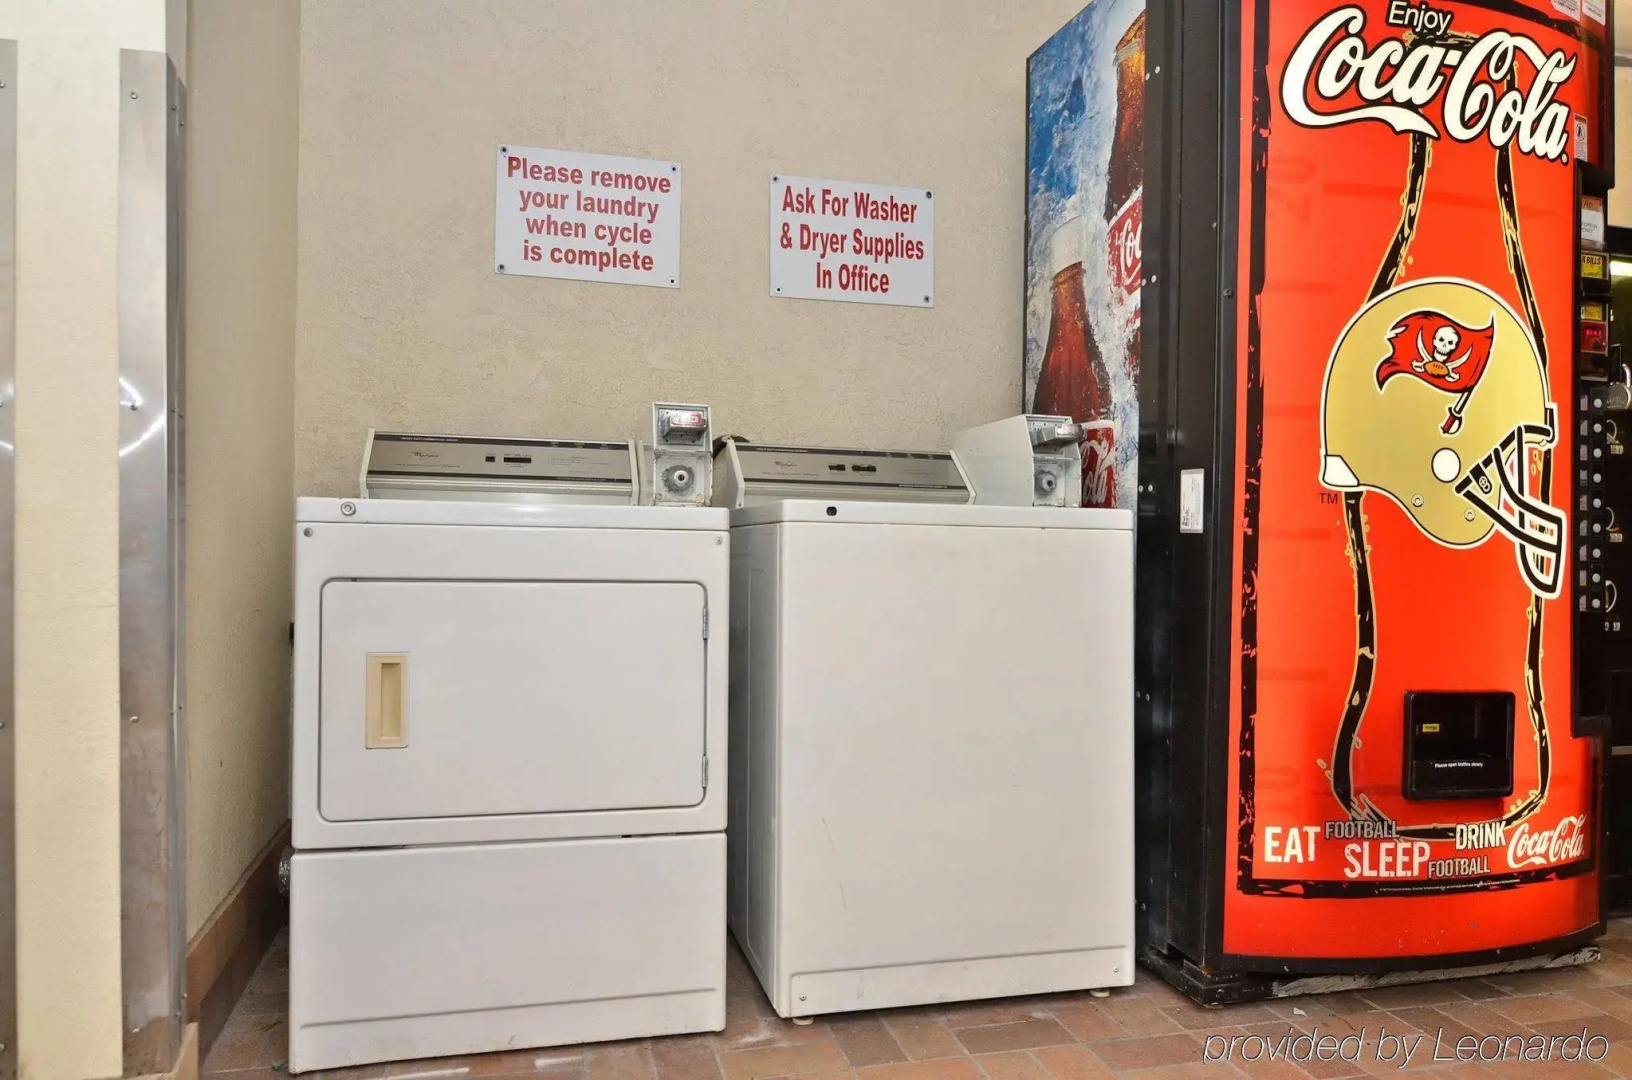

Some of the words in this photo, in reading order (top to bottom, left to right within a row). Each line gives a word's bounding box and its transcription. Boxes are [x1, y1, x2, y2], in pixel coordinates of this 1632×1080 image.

[1388, 1, 1452, 35] Enjoy
[1281, 6, 1577, 162] Coca-Cola
[507, 156, 583, 184] Please
[591, 170, 671, 193] remove
[519, 190, 569, 212] your
[576, 190, 659, 224] laundry
[782, 185, 815, 214] Ask
[821, 189, 849, 217] For
[854, 192, 917, 223] Washer
[526, 214, 586, 238] when
[594, 223, 652, 247] cycle
[780, 222, 792, 249] &
[800, 223, 847, 259] Dryer
[852, 228, 924, 264] Supplies
[523, 239, 542, 262] is
[550, 247, 654, 272] complete
[816, 262, 832, 289] In
[838, 264, 890, 293] Office
[1319, 492, 1339, 505] TM
[1264, 826, 1321, 863] EAT
[1325, 821, 1400, 840] FOOTBALL
[1455, 820, 1507, 850] DRINK
[1506, 814, 1586, 869] Coca-Cola
[1343, 841, 1431, 878] SLEEP
[1428, 856, 1491, 879] FOOTBALL
